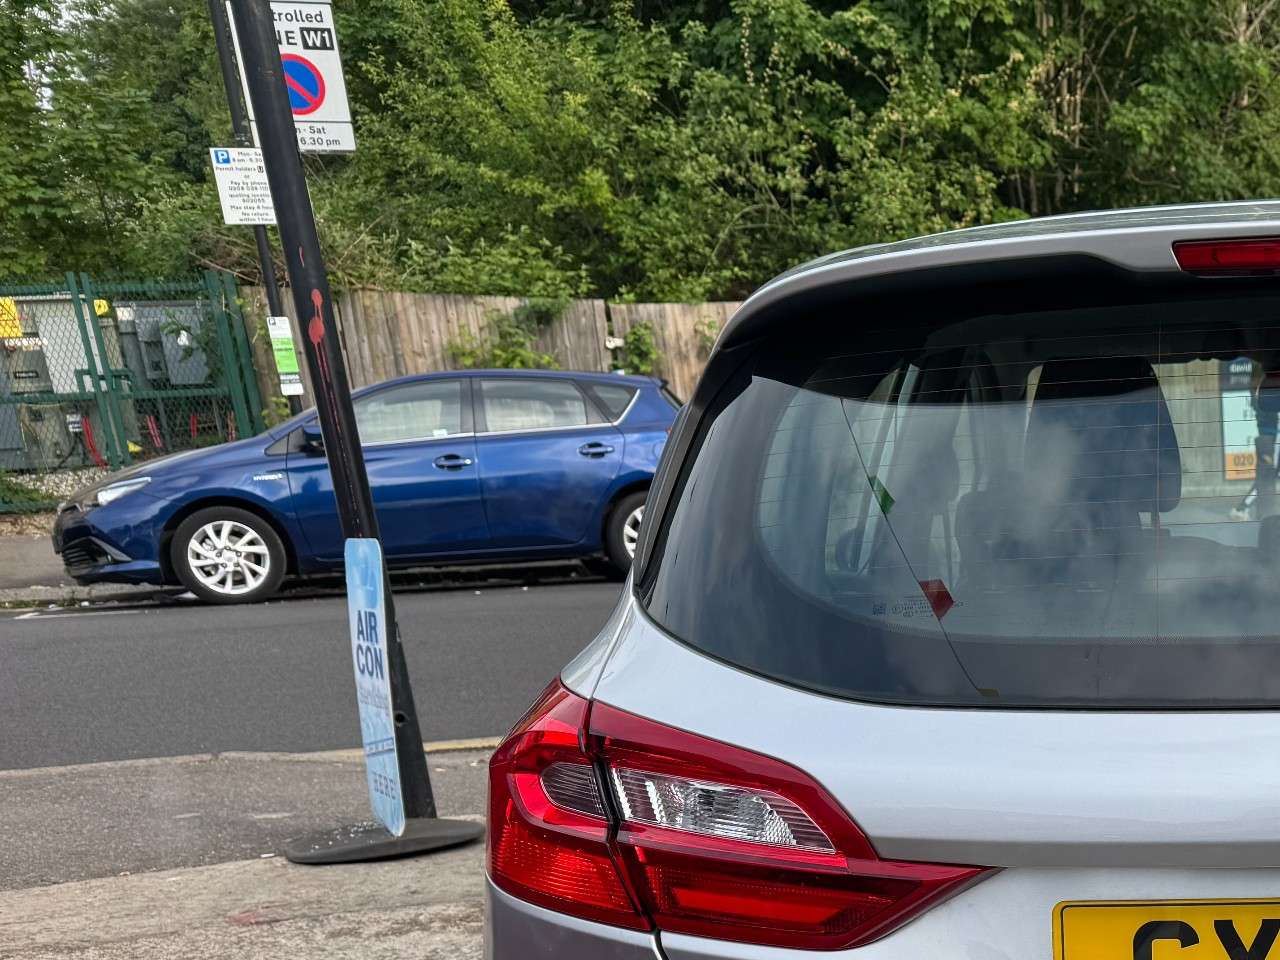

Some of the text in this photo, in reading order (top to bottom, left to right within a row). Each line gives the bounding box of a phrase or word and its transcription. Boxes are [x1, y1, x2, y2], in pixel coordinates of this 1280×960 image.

[303, 30, 331, 48] W1
[309, 126, 327, 135] Sat
[300, 137, 341, 148] 6.30 pm
[356, 609, 379, 646] AIR
[356, 644, 384, 681] CON
